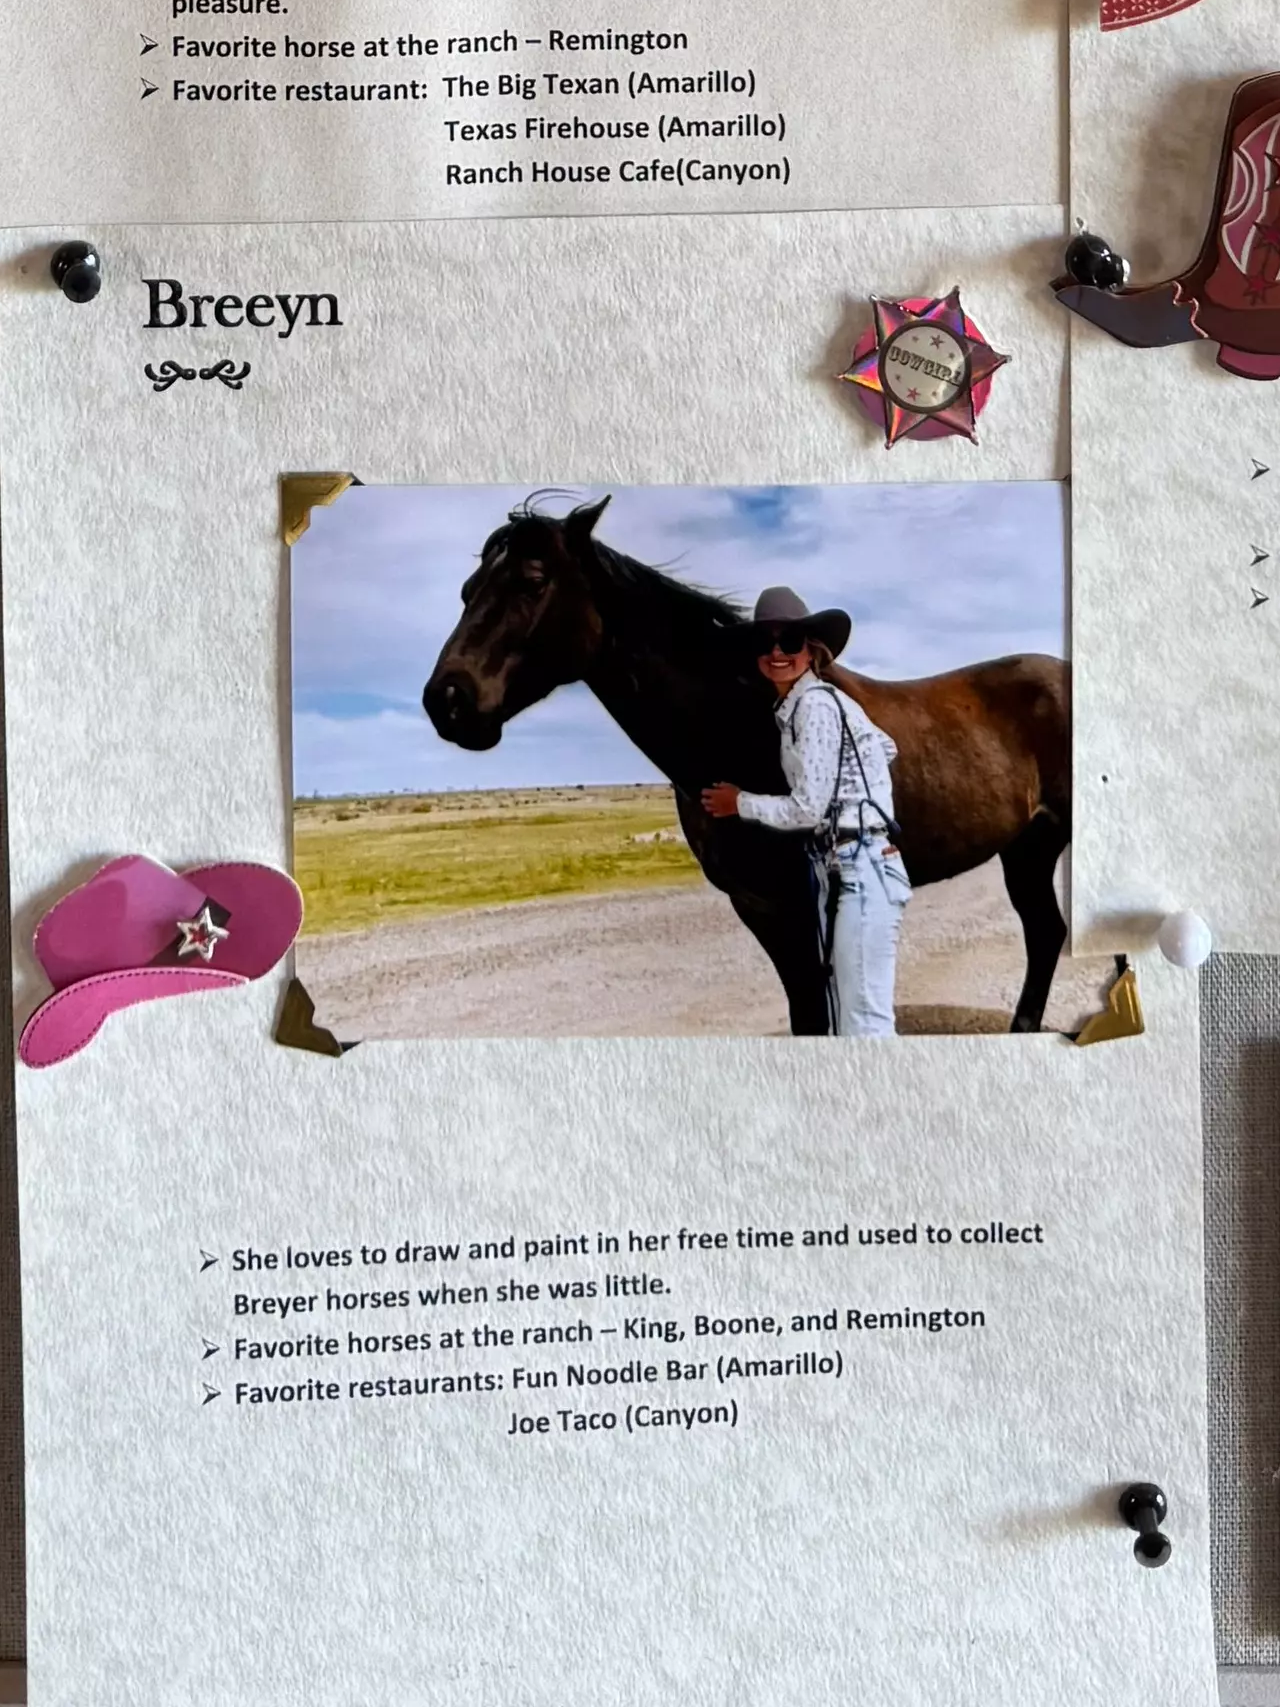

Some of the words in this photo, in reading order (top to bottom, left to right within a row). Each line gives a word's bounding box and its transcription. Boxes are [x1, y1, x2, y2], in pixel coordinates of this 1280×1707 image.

[443, 120, 517, 142] Texas
[525, 115, 650, 140] Firehouse
[658, 112, 786, 143] (Amarillo)
[446, 160, 523, 186] Ranch
[532, 161, 611, 183] House
[619, 156, 791, 187] Cafe(Canyon)
[143, 278, 343, 339] Breeyn
[888, 345, 962, 387] COWGIRL
[234, 1294, 319, 1320] Breyer
[326, 1287, 410, 1312] horses
[417, 1282, 488, 1306] when
[496, 1278, 541, 1303] she
[547, 1281, 598, 1300] was
[605, 1272, 671, 1298] little.
[507, 1412, 551, 1435] Joe
[556, 1409, 617, 1432] Taco
[625, 1398, 738, 1434] (Canyon)
